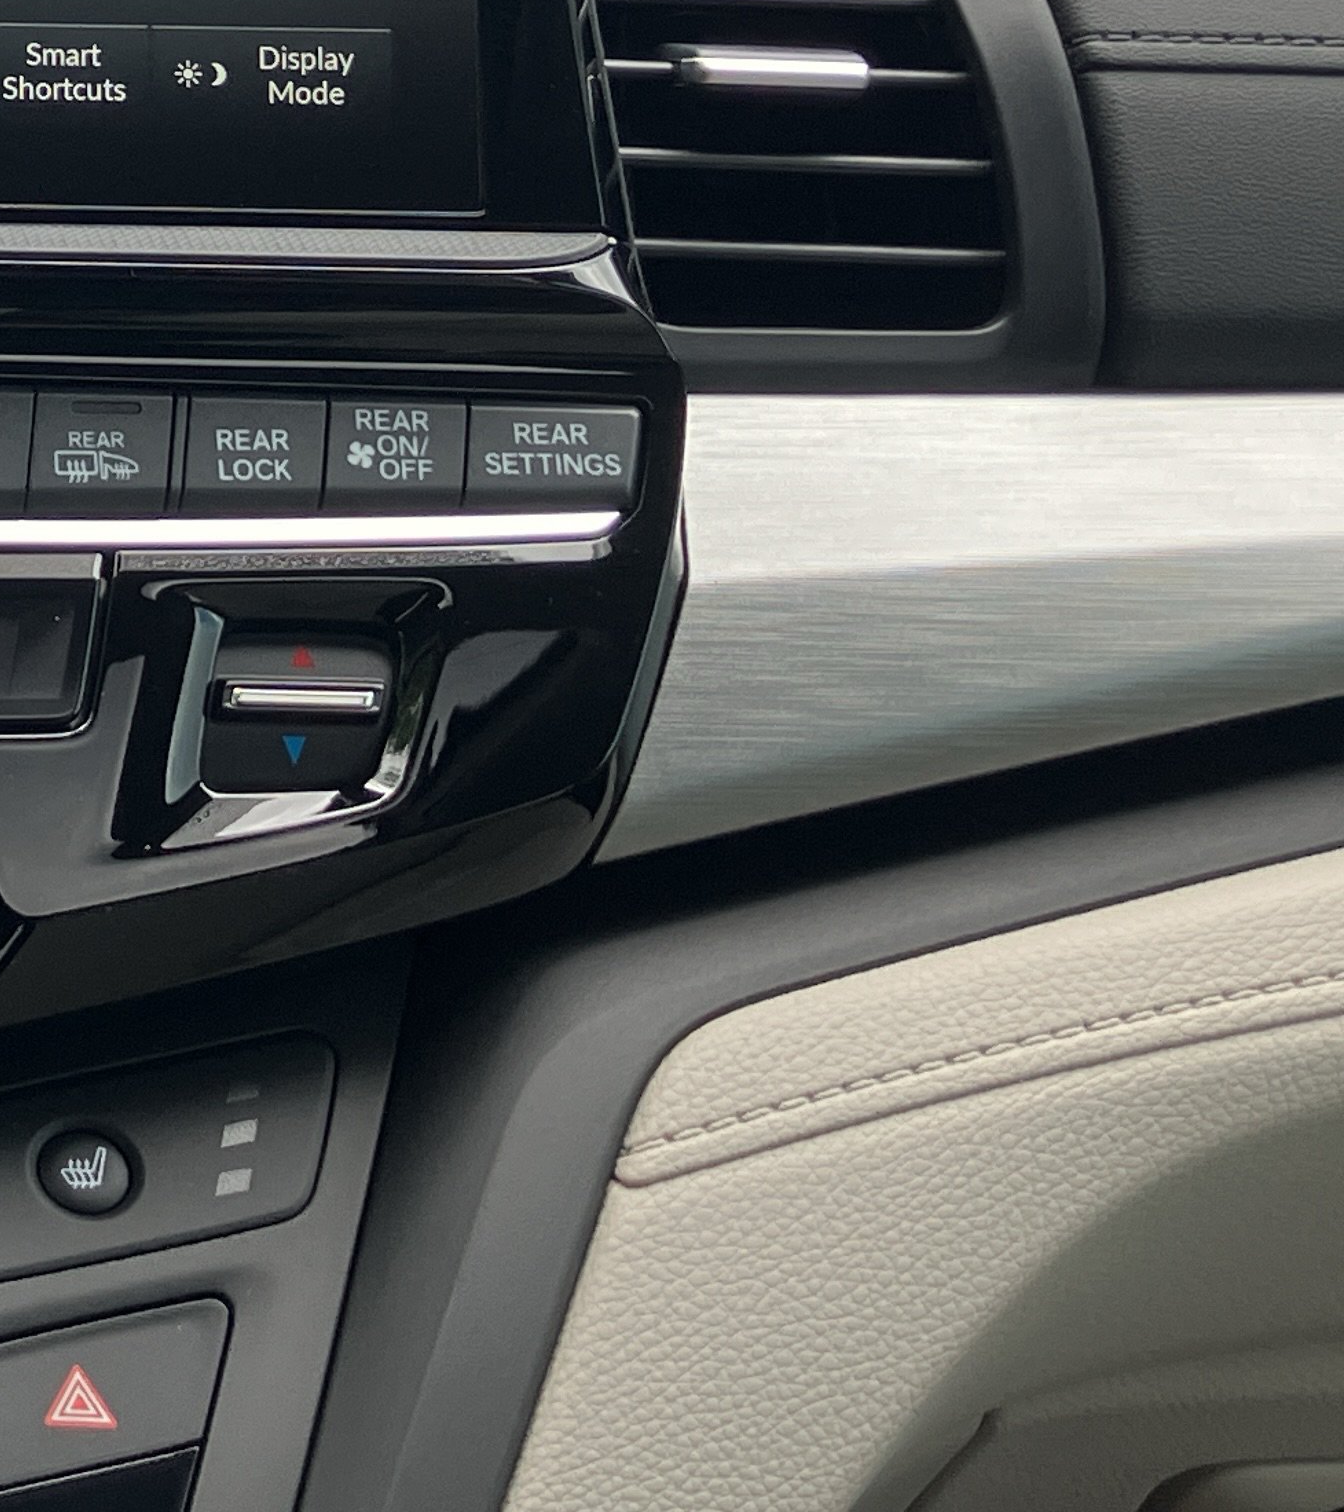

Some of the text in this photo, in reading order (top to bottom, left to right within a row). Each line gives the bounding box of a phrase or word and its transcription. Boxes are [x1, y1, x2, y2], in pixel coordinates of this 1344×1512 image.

[26, 42, 102, 67] Smart
[259, 45, 355, 77] Display
[2, 75, 127, 102] Shortcuts
[268, 80, 345, 106] Mode
[355, 408, 430, 432] REAR
[67, 431, 125, 449] REAR
[215, 428, 290, 452] REAR
[376, 434, 429, 457] ON/
[513, 422, 589, 446] REAR
[218, 458, 292, 481] LOCK
[379, 458, 433, 481] OFF
[484, 452, 622, 476] SETTINGS
